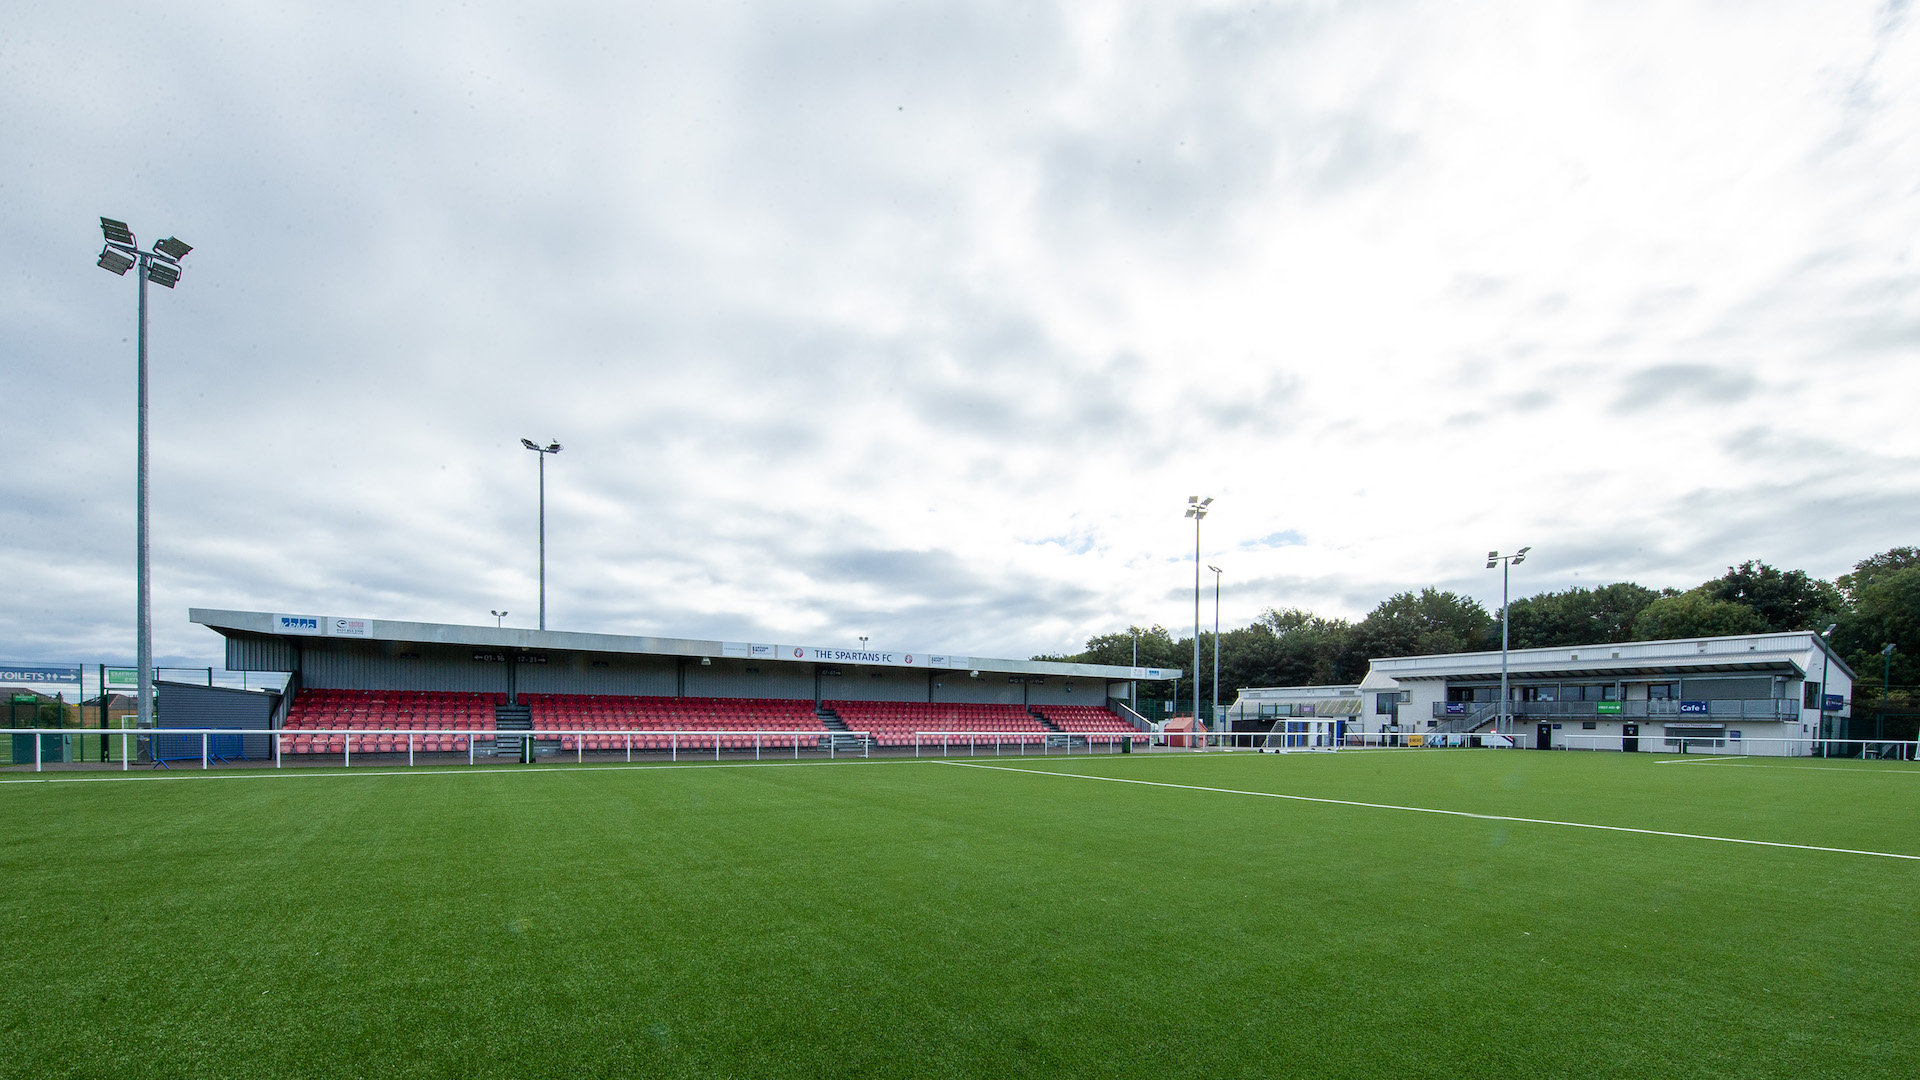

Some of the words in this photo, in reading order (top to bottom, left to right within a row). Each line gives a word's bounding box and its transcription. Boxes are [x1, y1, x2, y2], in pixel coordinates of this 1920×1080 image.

[814, 649, 832, 659] THE
[835, 651, 880, 662] SPARTANS
[882, 654, 893, 662] FC
[0, 671, 45, 681] TOILETS
[1681, 704, 1700, 712] Cafe
